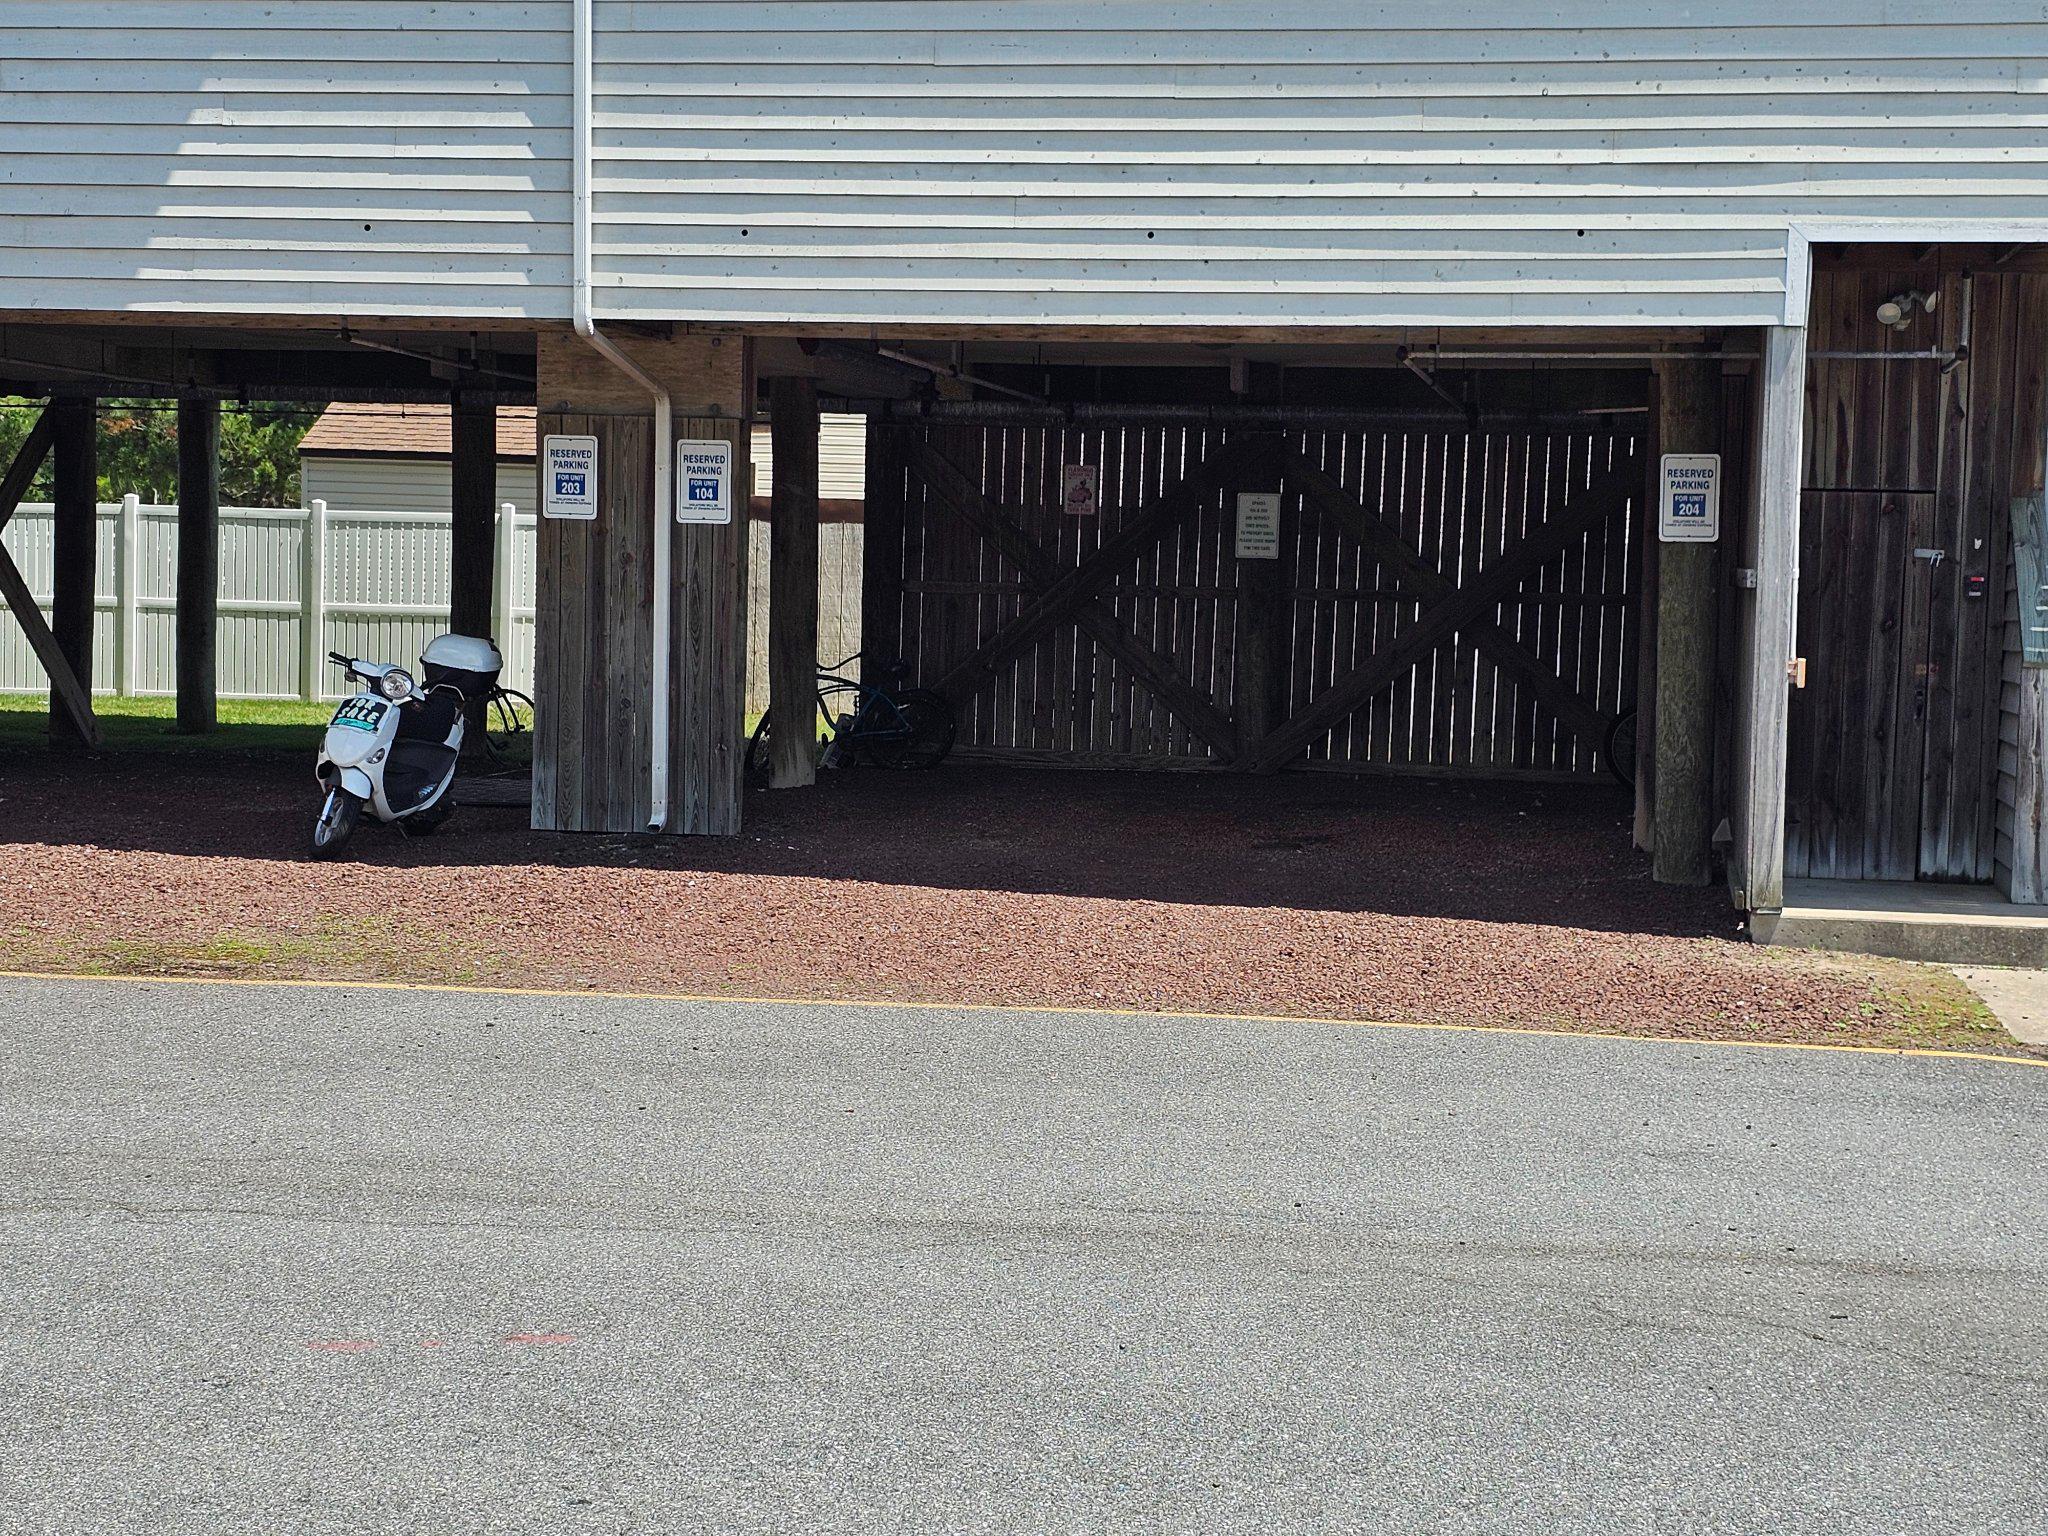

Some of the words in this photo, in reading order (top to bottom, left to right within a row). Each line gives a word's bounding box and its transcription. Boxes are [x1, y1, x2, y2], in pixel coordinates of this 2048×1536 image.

[550, 449, 592, 458] RESERVED
[683, 454, 726, 464] RESERVED
[554, 460, 588, 470] PARKING
[686, 466, 722, 475] PARKING
[1667, 469, 1714, 478] RESERVED
[562, 482, 580, 494] 203
[1670, 481, 1710, 490] PARKING
[695, 488, 713, 499] 104
[1679, 503, 1699, 515] 204
[349, 698, 376, 710] FOR
[338, 706, 380, 724] SALE
